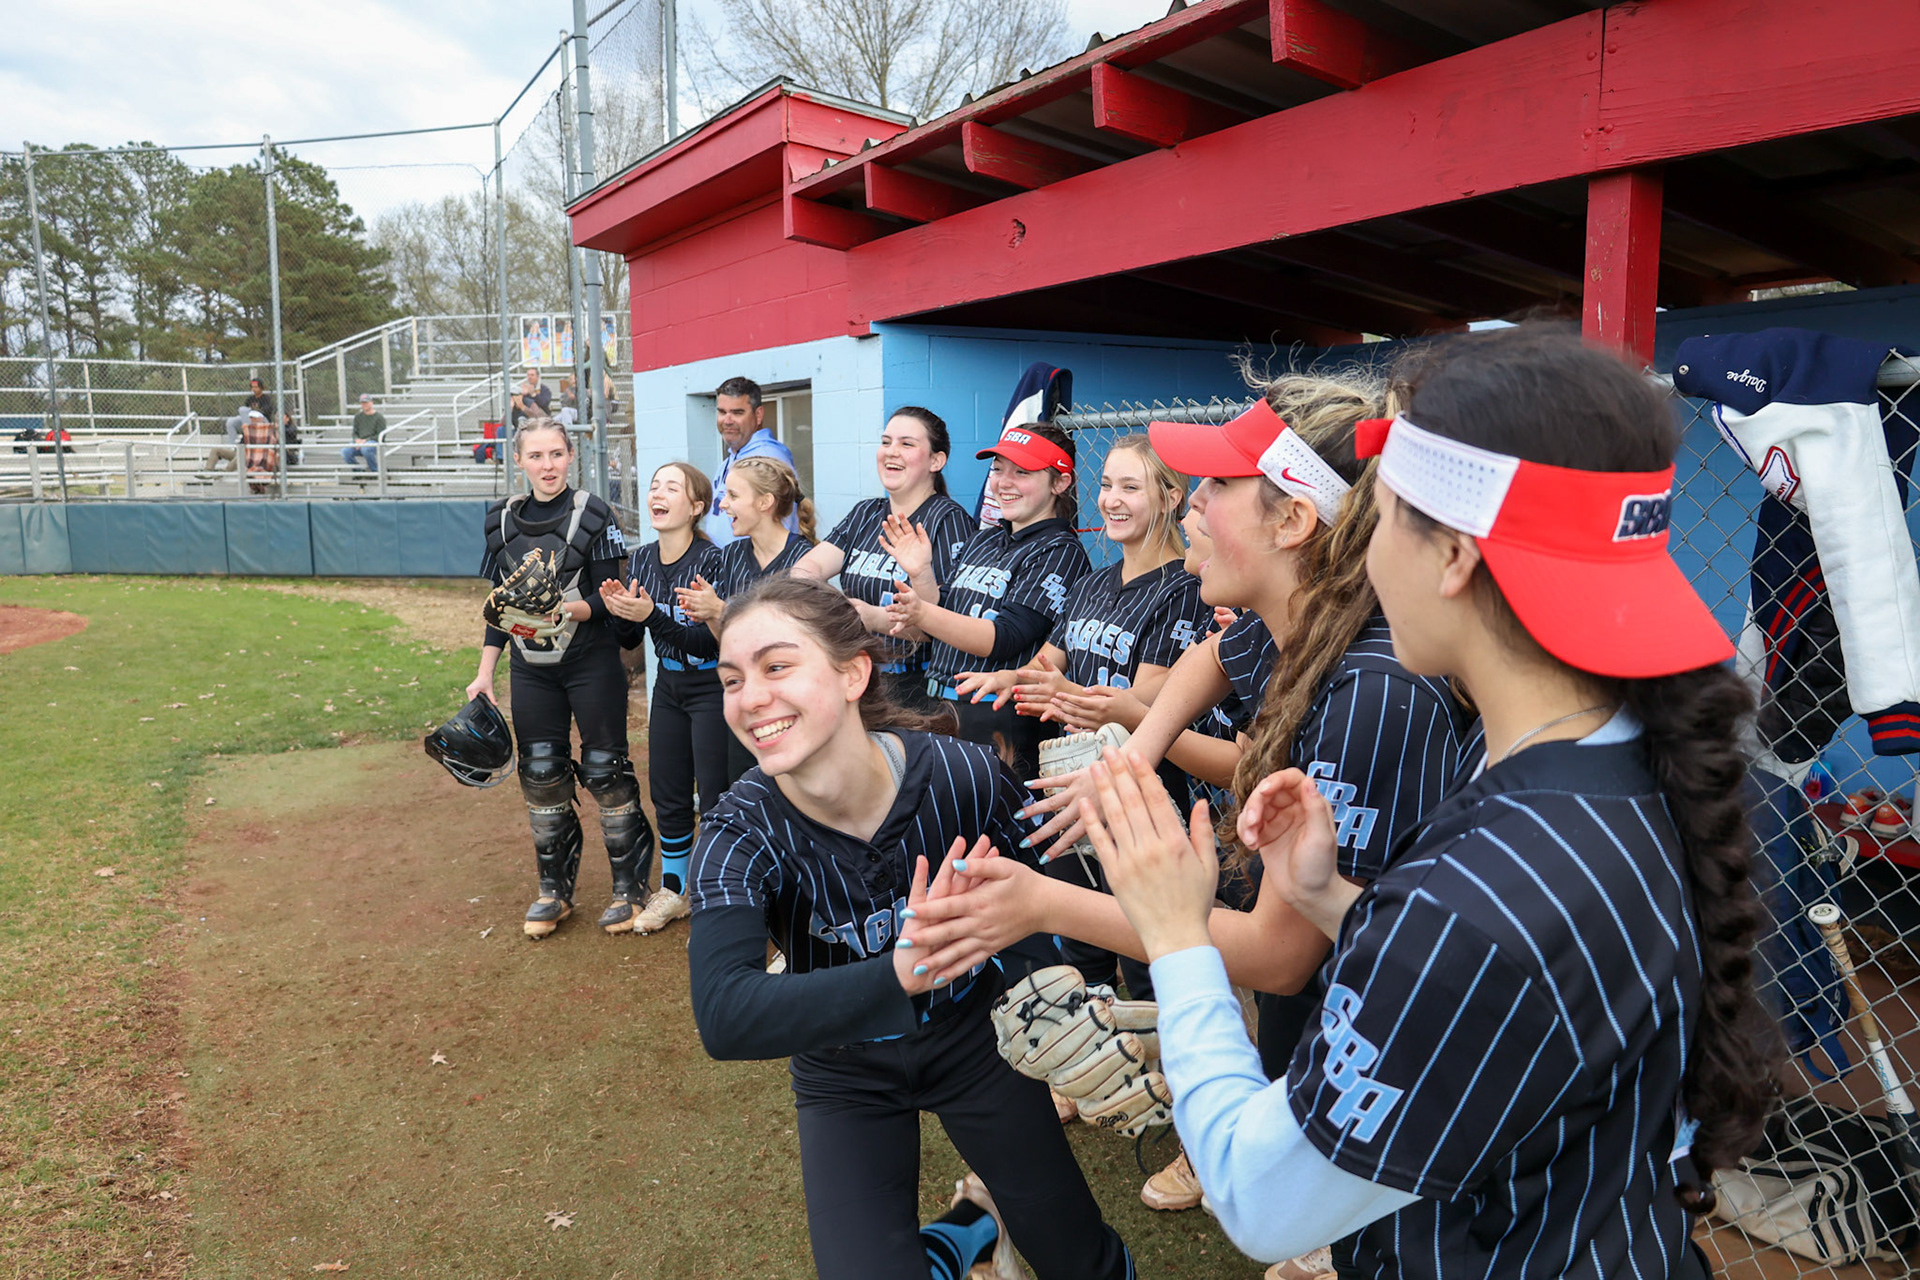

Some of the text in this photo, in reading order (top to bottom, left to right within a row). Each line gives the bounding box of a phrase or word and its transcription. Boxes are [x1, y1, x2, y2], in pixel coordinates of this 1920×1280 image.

[1004, 431, 1031, 445] SBA
[1170, 619, 1198, 650] SB
[1321, 983, 1405, 1143] SBA
